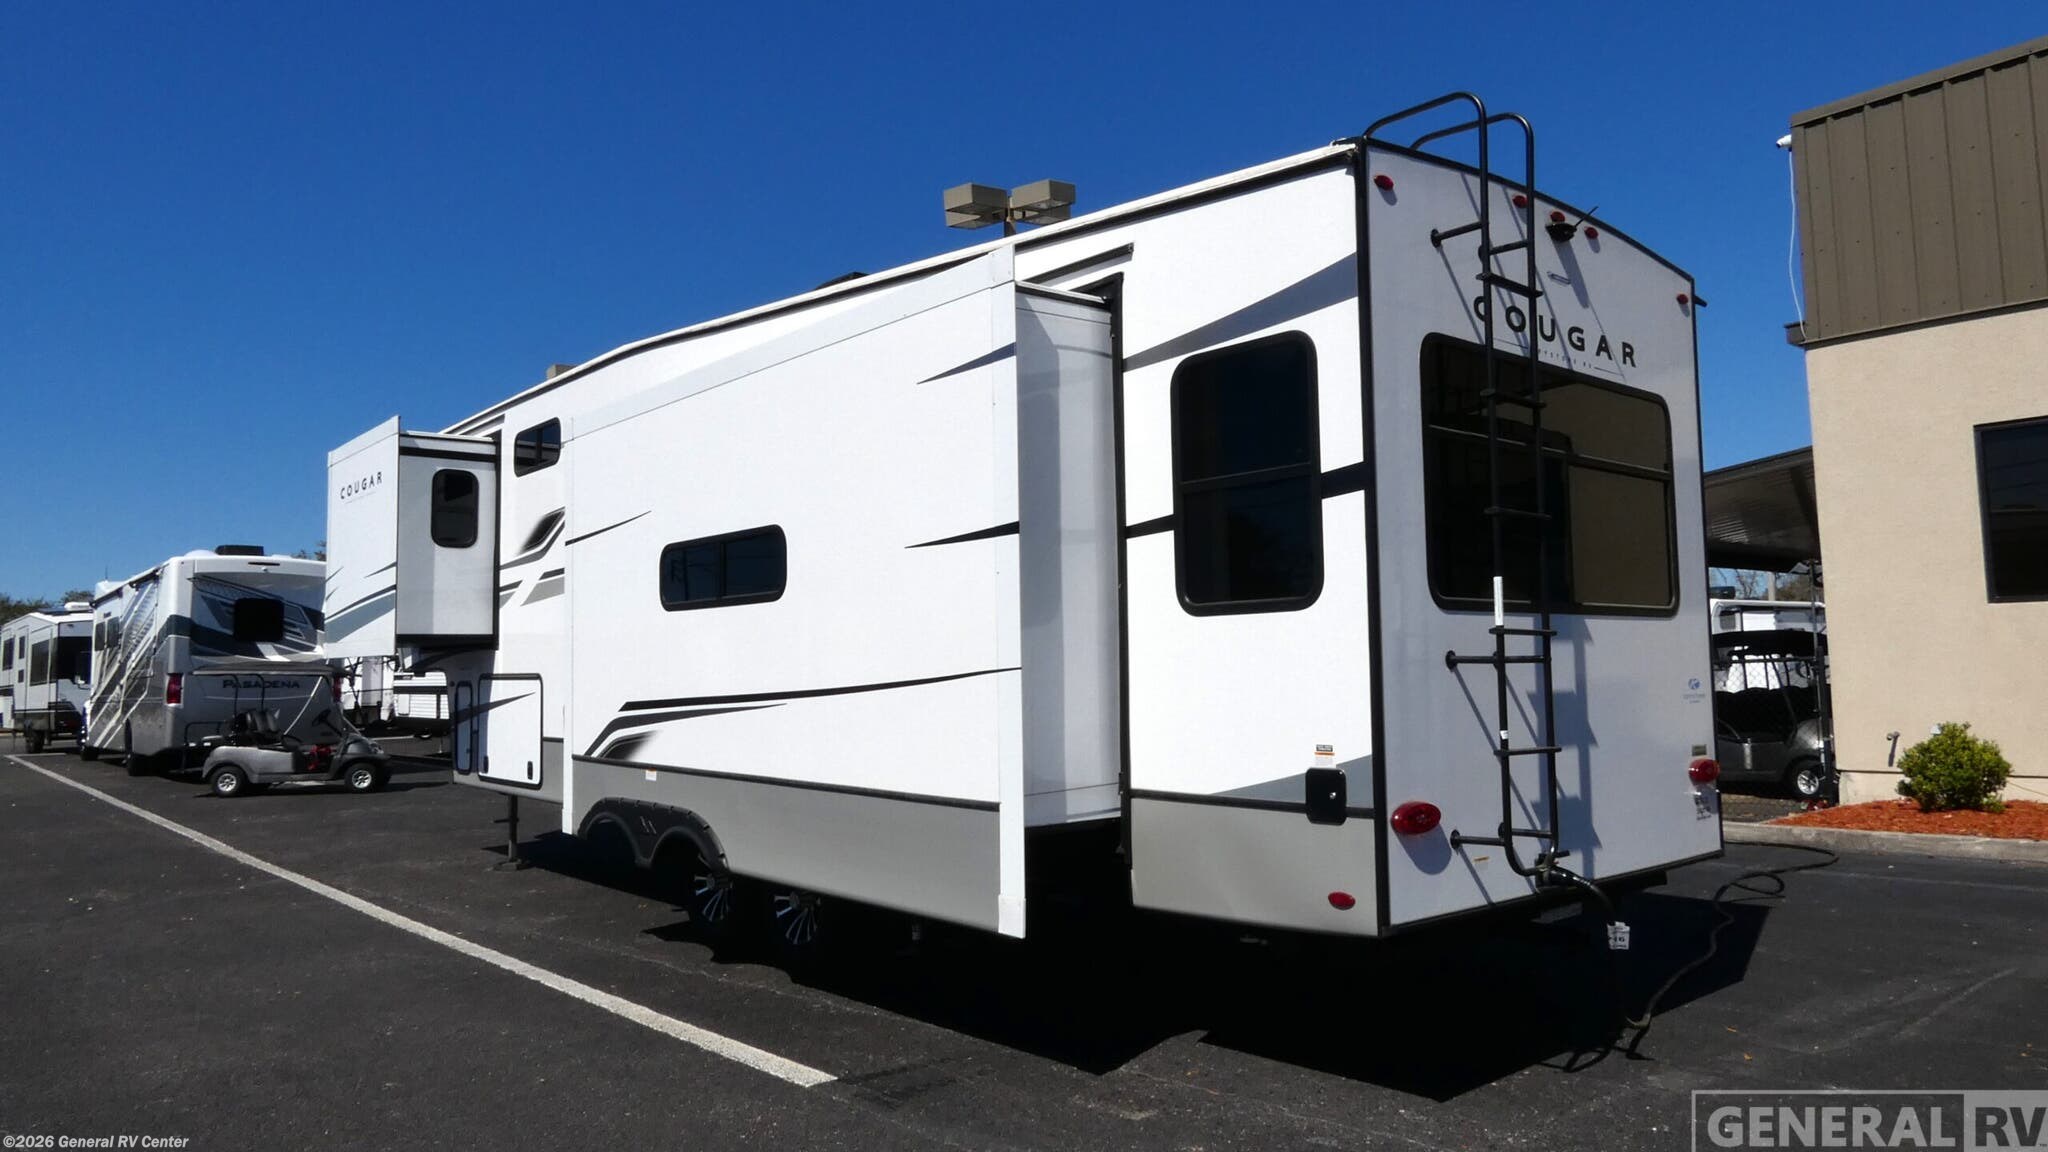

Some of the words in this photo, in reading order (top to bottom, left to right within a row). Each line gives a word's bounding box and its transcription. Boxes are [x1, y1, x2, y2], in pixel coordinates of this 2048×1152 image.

[1473, 295, 1637, 368] COUGAR
[340, 471, 382, 499] COUGAR
[222, 679, 300, 689] PASADENA
